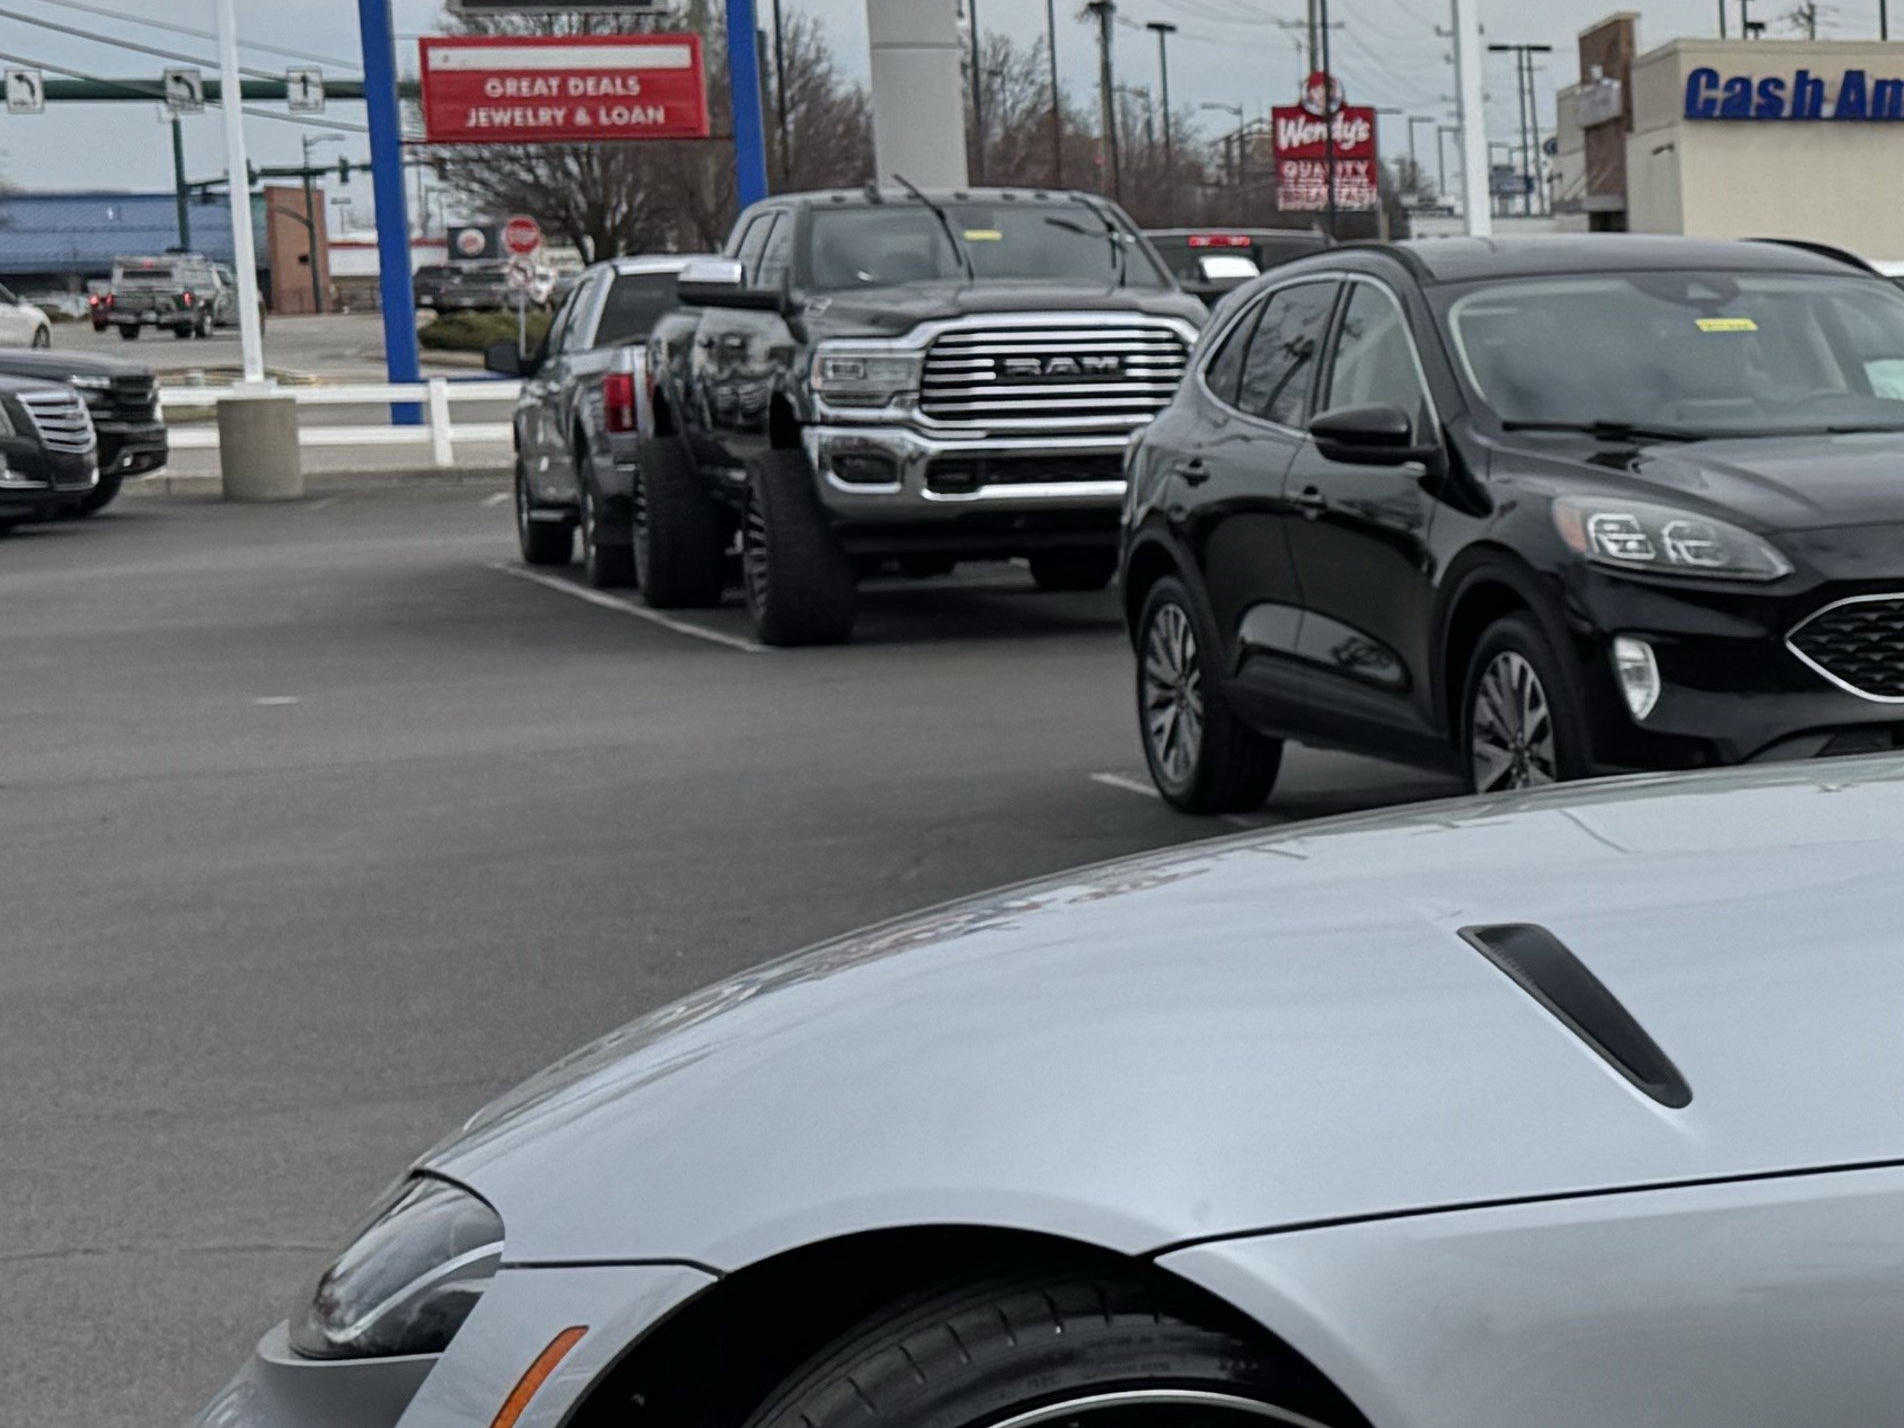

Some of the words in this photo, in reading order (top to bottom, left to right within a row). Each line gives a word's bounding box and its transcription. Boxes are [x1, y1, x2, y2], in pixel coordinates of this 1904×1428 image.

[484, 77, 560, 98] GREAT
[568, 75, 641, 96] DEALS
[1685, 66, 1824, 120] Cash
[466, 108, 565, 128] JEWELRY
[573, 108, 592, 126] &
[600, 106, 665, 125] LOAN
[1282, 160, 1369, 178] QUAITY
